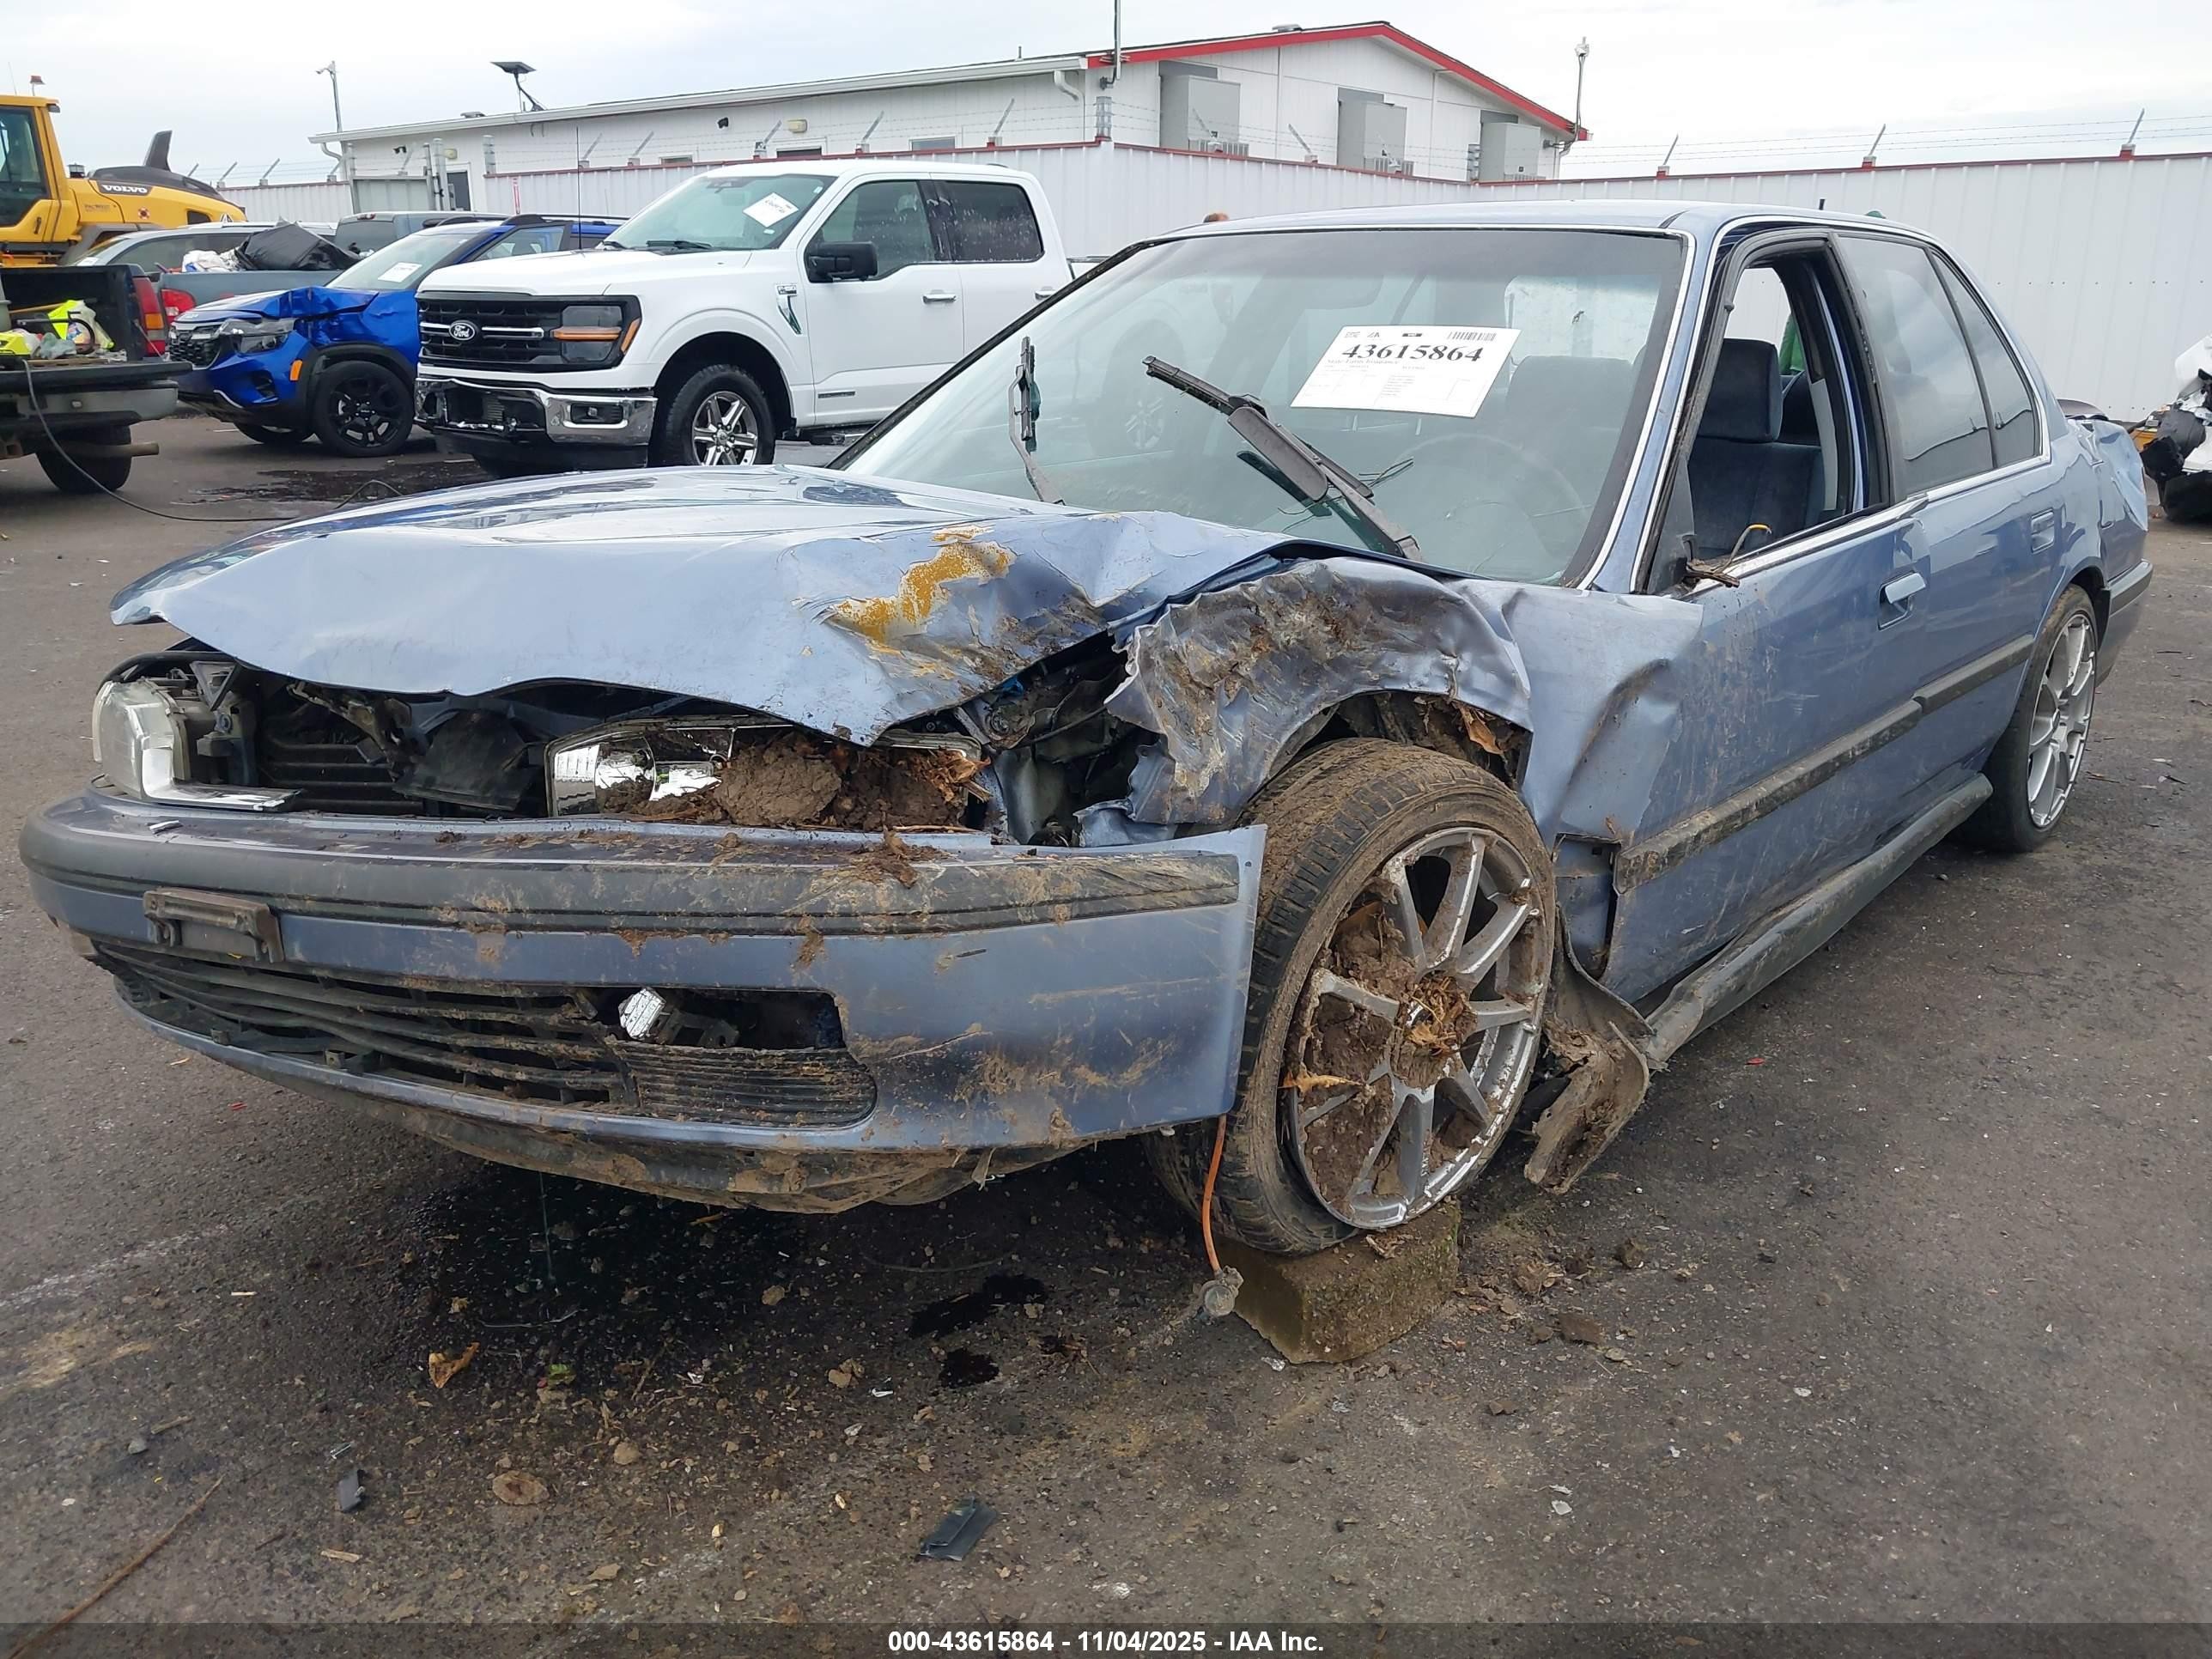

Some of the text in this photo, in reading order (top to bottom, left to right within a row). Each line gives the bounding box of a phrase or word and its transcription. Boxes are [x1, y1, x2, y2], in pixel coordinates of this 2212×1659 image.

[101, 184, 148, 193] VOLVO
[454, 325, 471, 337] Ford
[1341, 343, 1485, 362] 43615864
